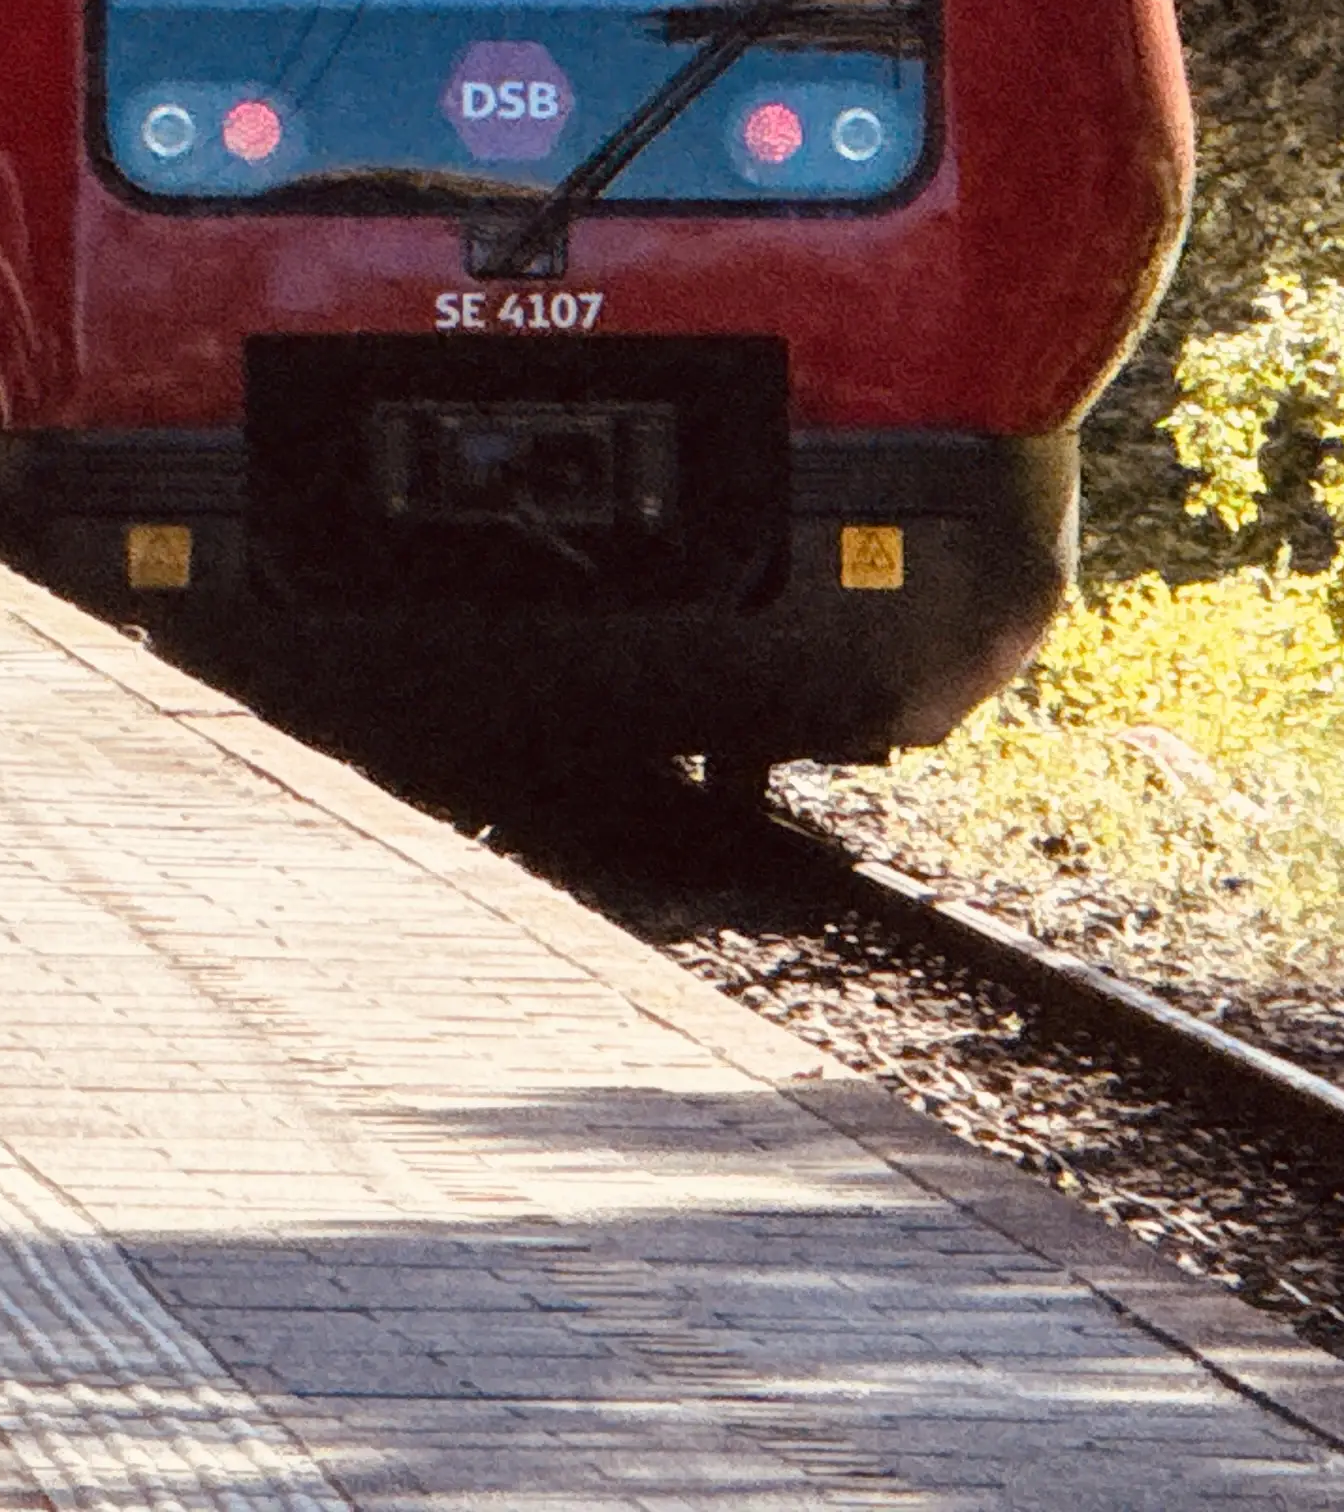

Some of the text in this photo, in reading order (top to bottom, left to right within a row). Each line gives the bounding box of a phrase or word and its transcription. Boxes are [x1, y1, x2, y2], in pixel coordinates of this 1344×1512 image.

[461, 80, 559, 120] DSB
[434, 291, 605, 330] SE 4107
